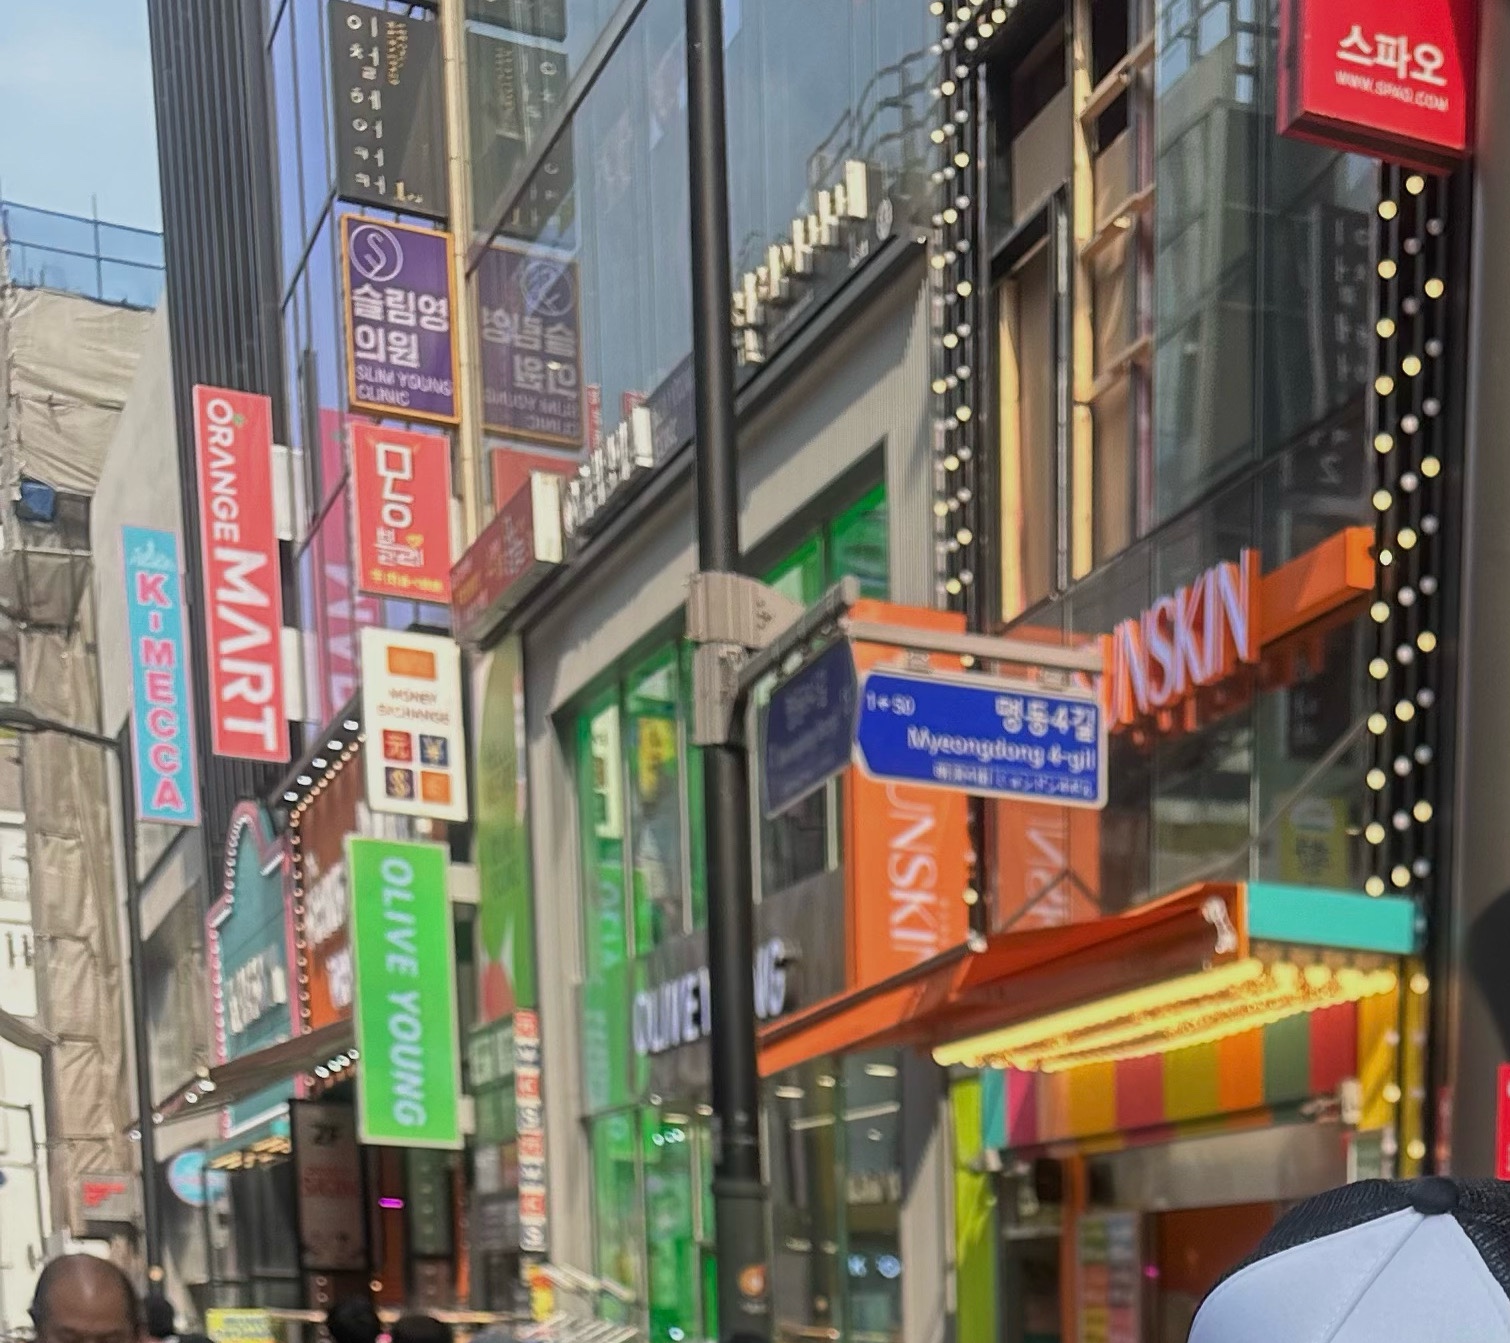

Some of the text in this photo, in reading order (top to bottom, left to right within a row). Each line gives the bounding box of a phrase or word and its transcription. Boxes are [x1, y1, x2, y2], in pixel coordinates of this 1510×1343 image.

[1336, 25, 1447, 86] 스파오
[352, 283, 449, 332] 슬림영
[355, 324, 420, 369] 의원
[355, 364, 452, 396] SLIM YOUNG
[356, 383, 410, 406] CLINIC
[207, 397, 278, 752] ORANGE MART
[136, 572, 184, 811] KIMECCA
[995, 695, 1096, 743] 명동4길
[907, 725, 1045, 770] Myeongdong
[380, 856, 427, 1127] OLIVE YOUNG
